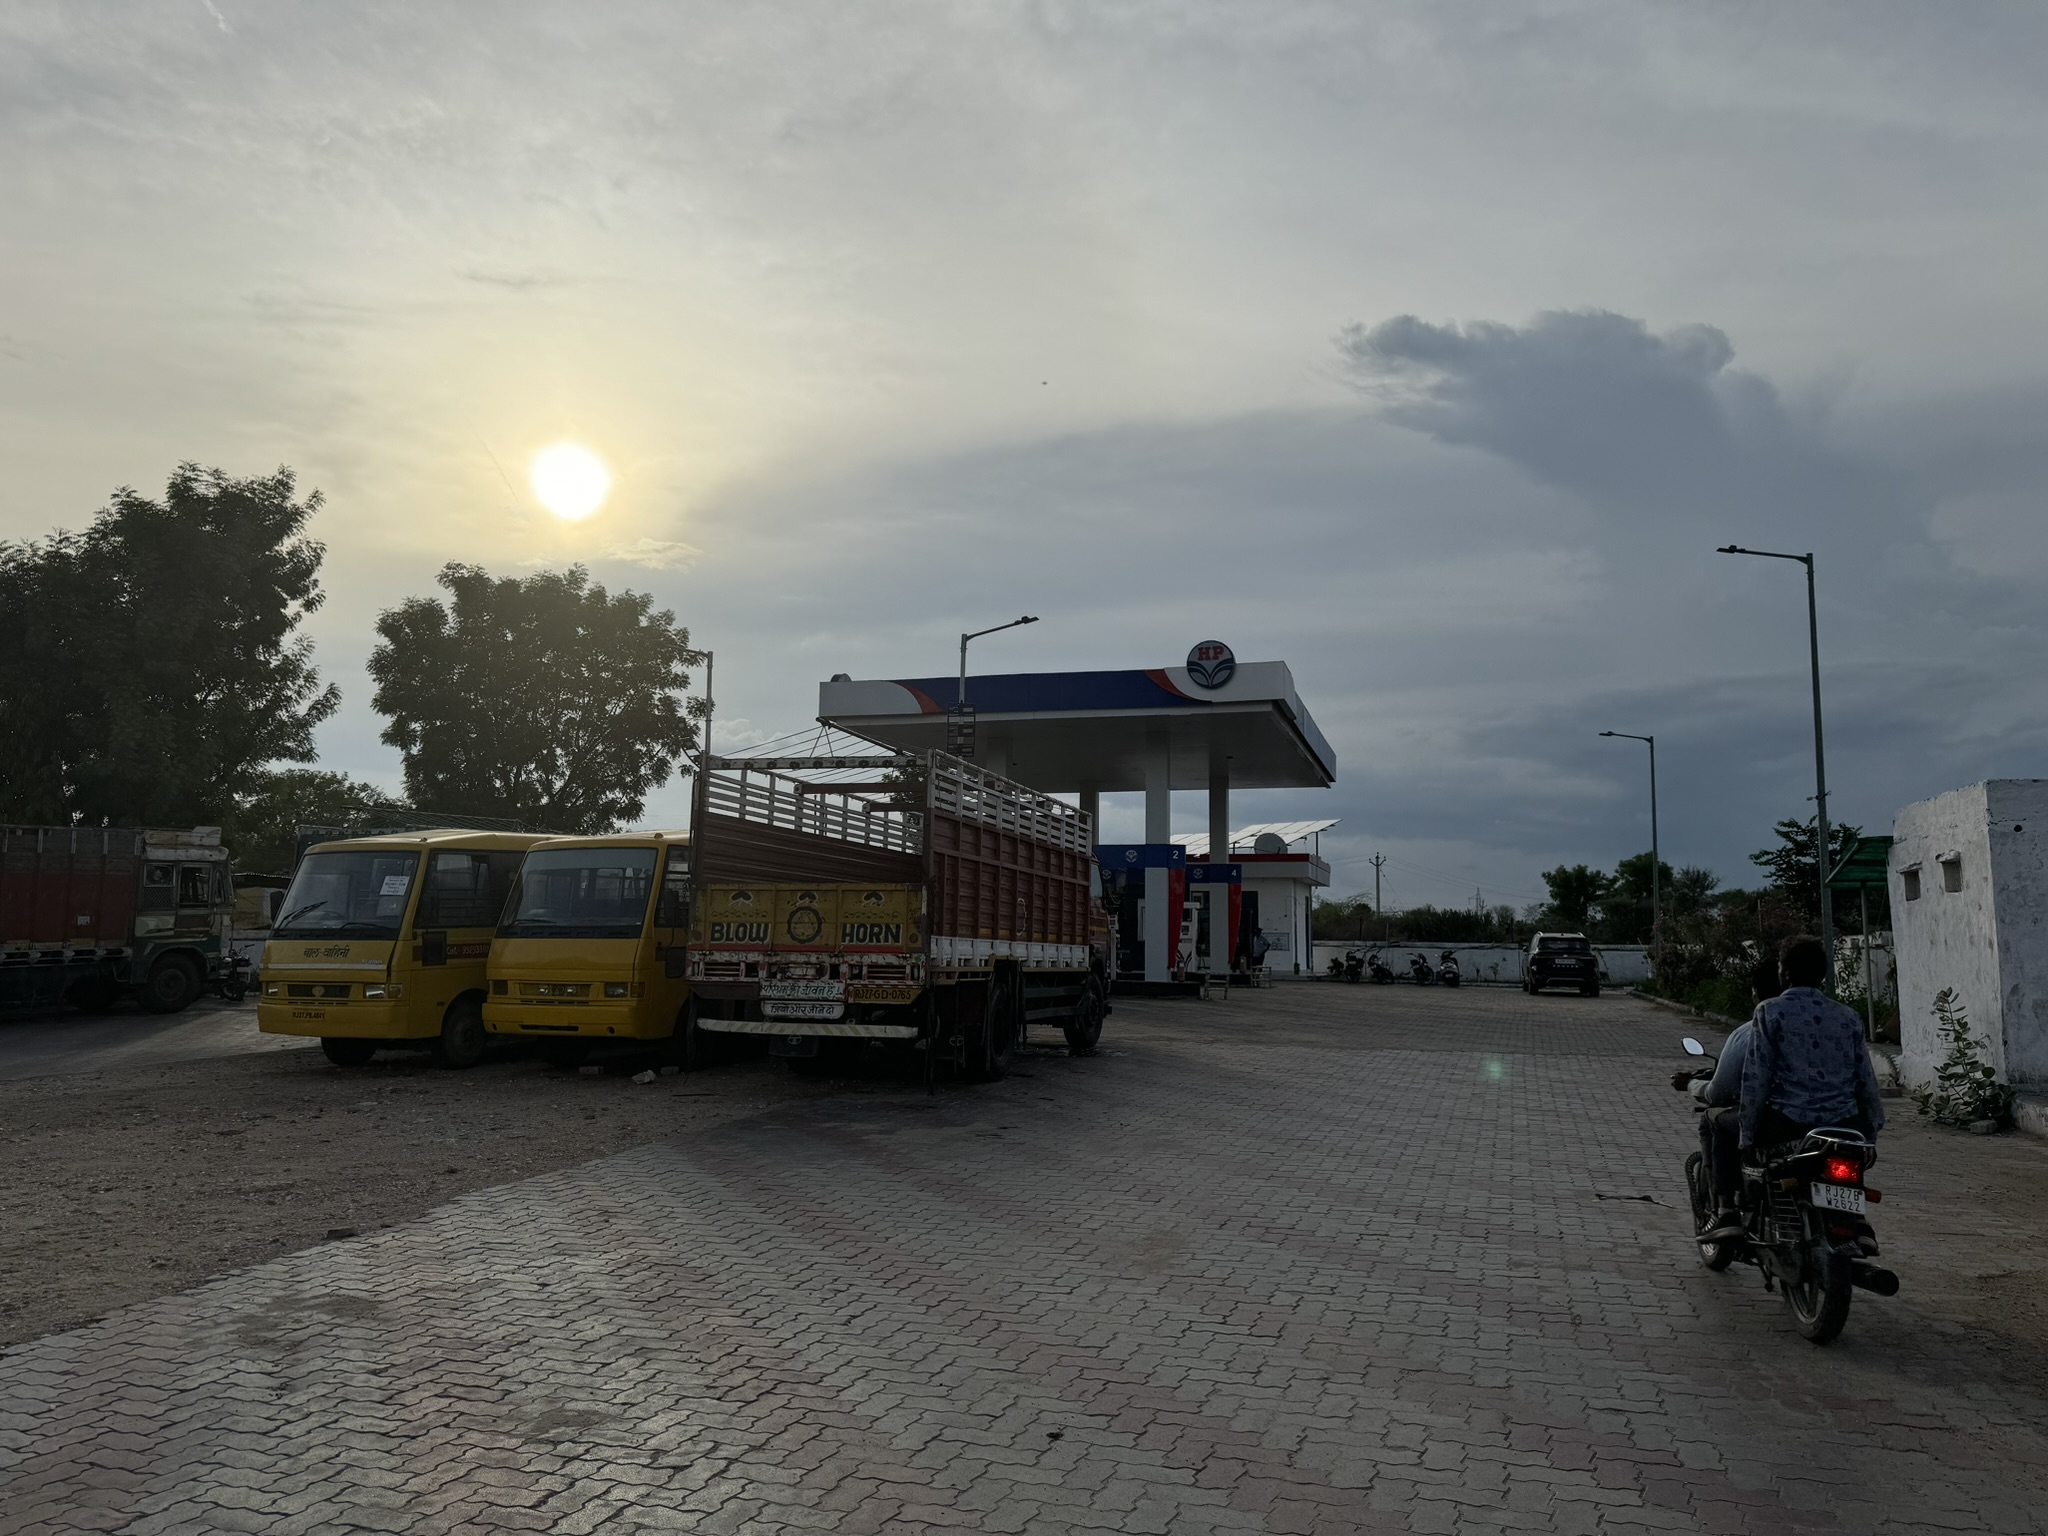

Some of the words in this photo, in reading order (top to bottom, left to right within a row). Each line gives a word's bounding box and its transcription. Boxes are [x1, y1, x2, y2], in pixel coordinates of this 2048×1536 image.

[1197, 646, 1224, 661] HP
[1172, 850, 1179, 860] 2
[1231, 869, 1237, 877] 4
[710, 922, 771, 944] BLOW
[841, 923, 903, 944] HORN
